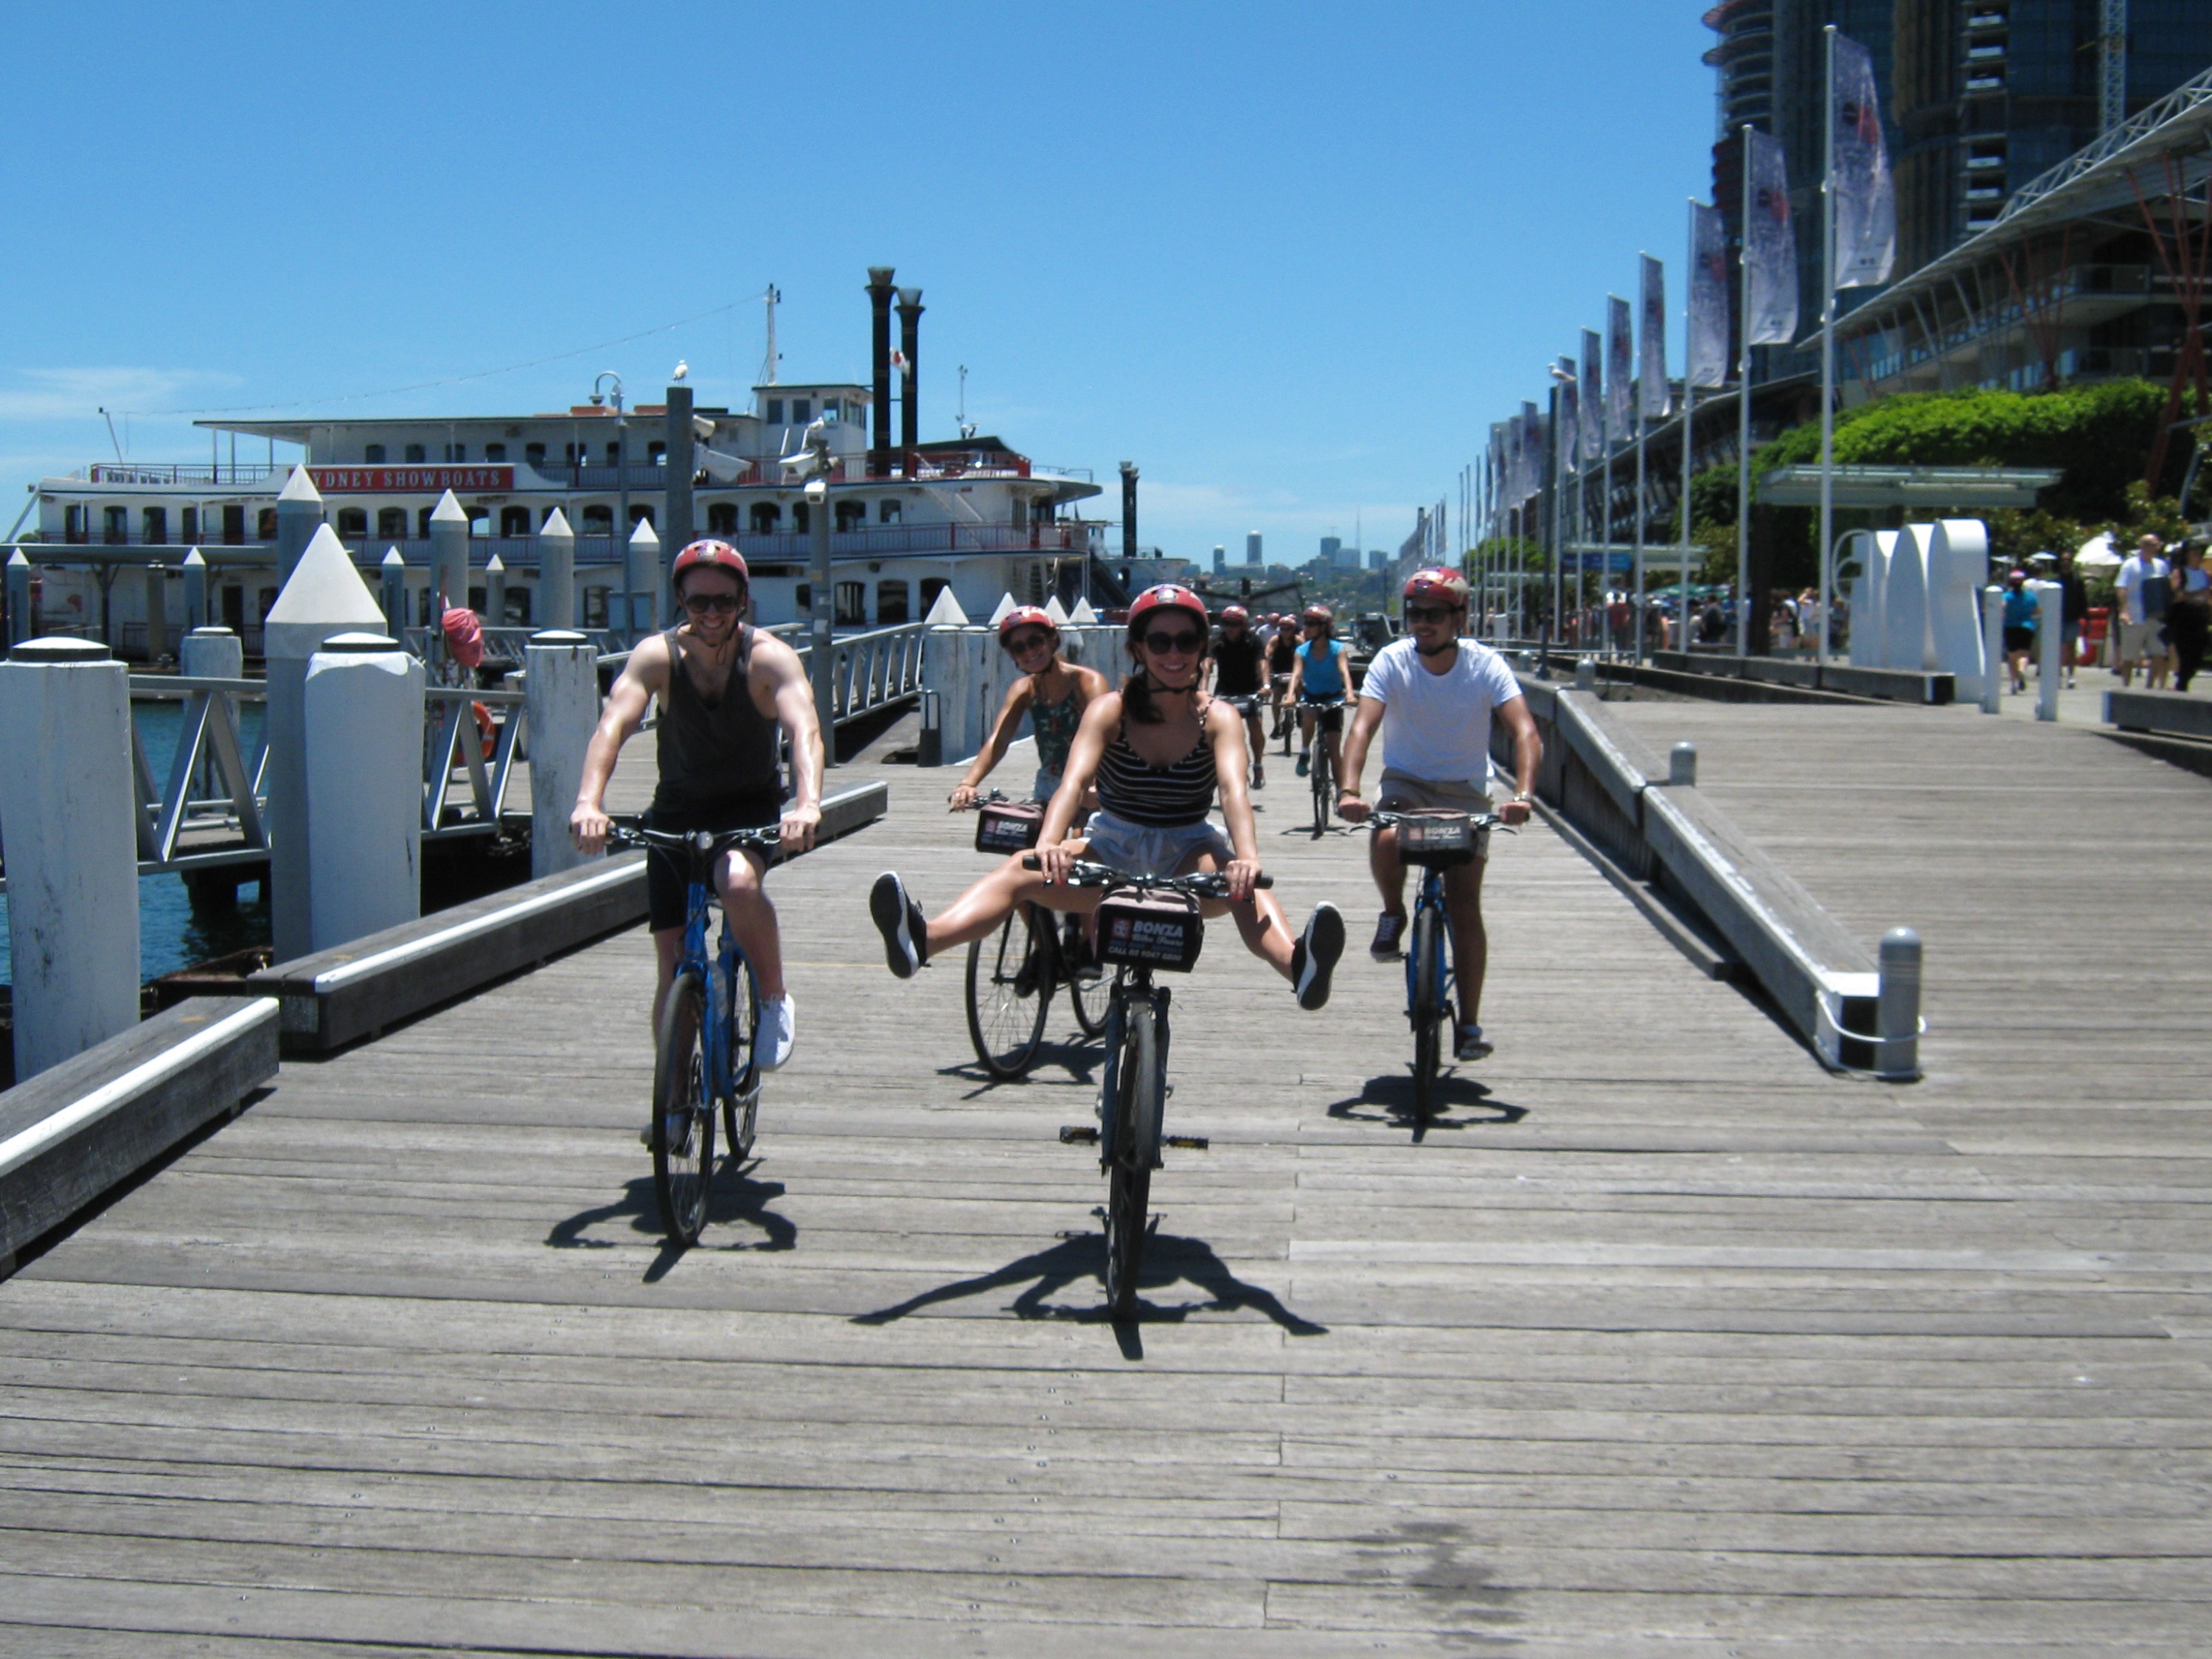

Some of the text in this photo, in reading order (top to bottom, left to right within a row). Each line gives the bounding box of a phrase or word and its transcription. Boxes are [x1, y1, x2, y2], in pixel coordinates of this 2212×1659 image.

[311, 469, 501, 488] YDNEY SHOWBOATS
[1133, 920, 1183, 938] BONZA
[1108, 946, 1127, 955] CALL
